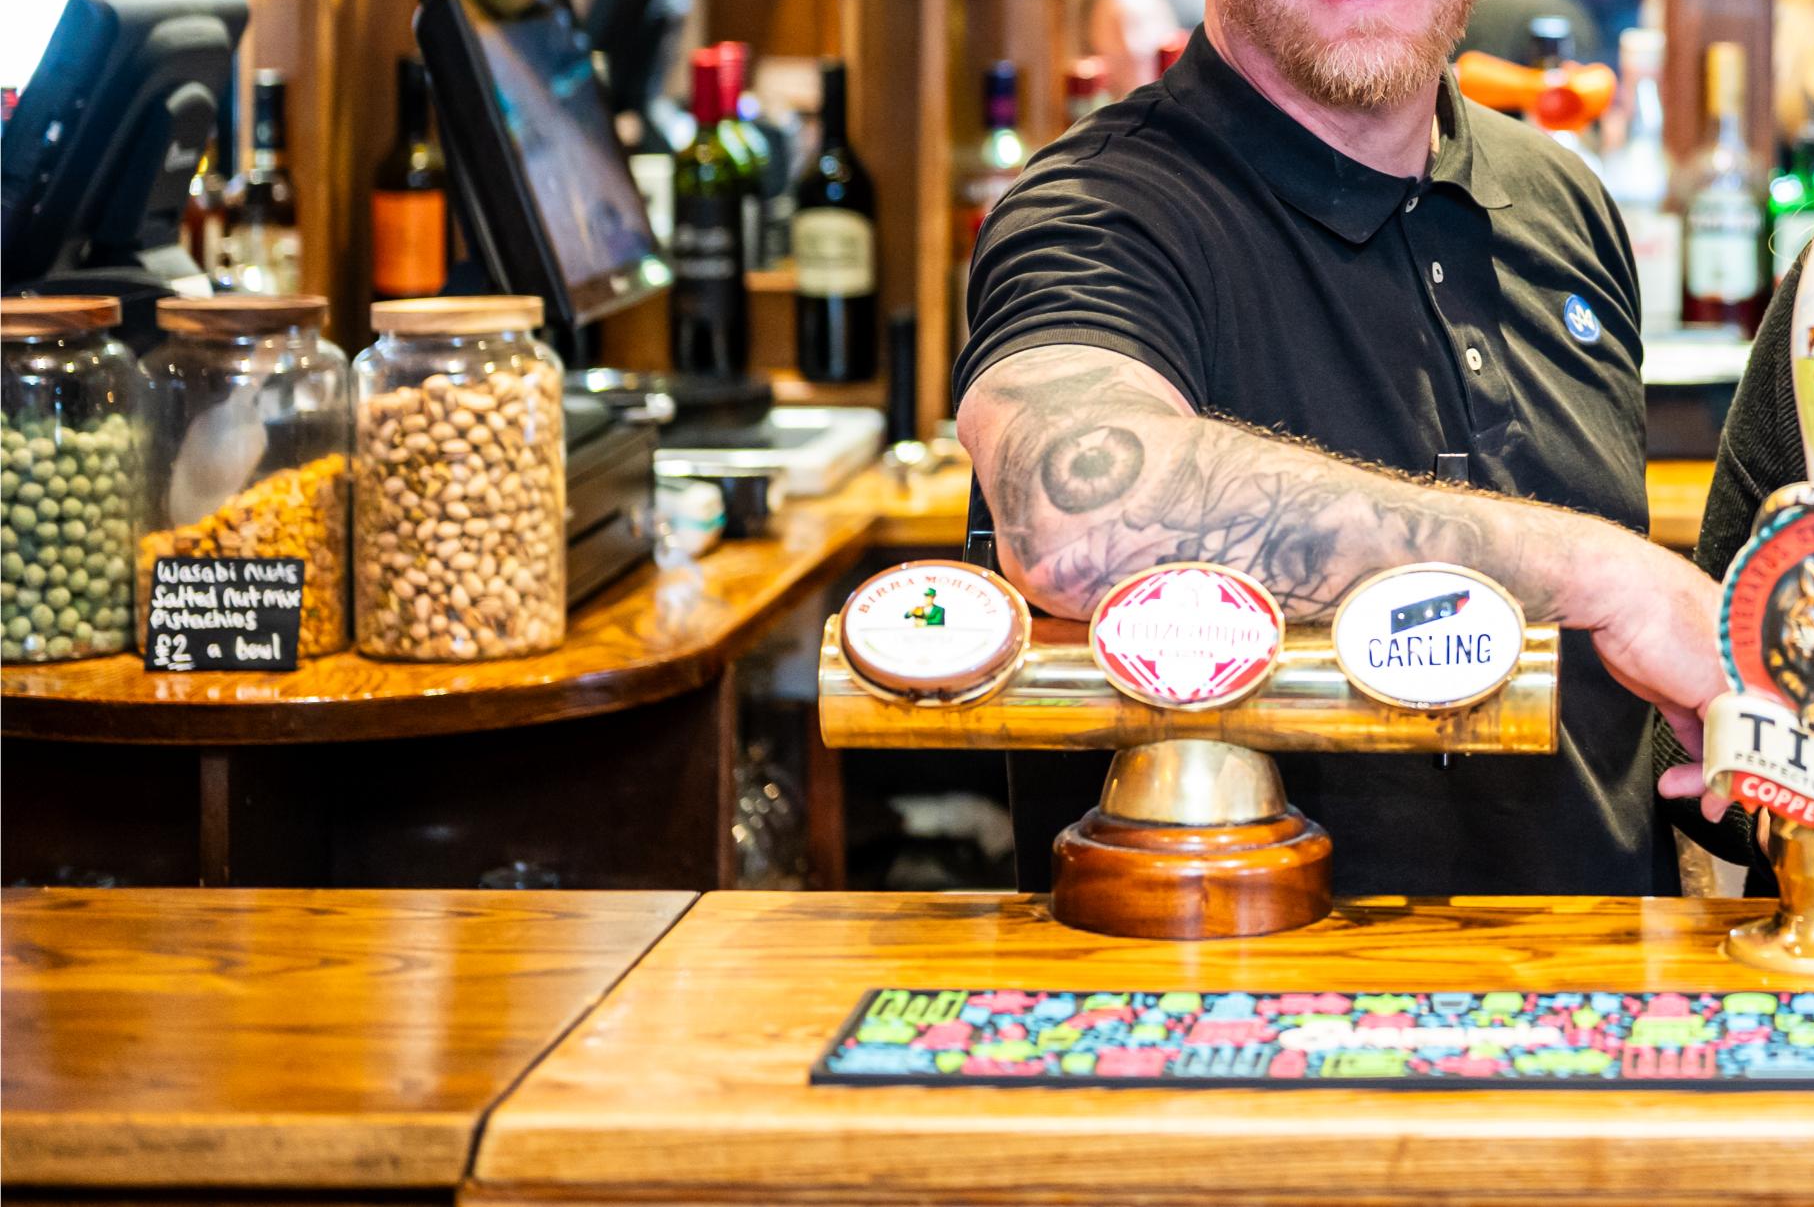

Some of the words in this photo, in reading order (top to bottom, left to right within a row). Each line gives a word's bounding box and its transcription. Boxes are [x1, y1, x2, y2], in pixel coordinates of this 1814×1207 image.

[156, 561, 238, 584] Wasabi
[152, 585, 219, 609] Salted
[857, 577, 915, 614] BIRRA
[150, 608, 258, 631] Pistachios
[154, 633, 194, 666] £2
[206, 642, 223, 659] a
[235, 632, 282, 661] bowl
[1367, 633, 1492, 669] CARLING
